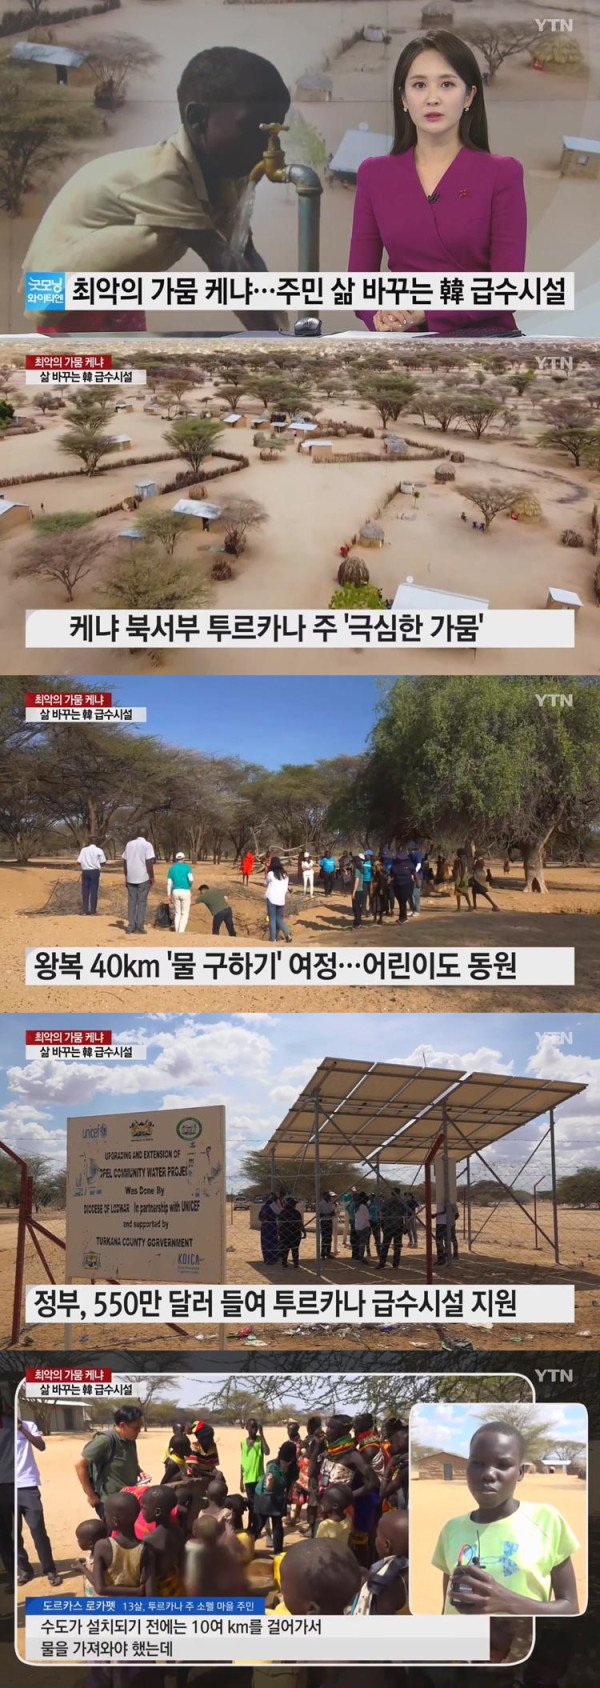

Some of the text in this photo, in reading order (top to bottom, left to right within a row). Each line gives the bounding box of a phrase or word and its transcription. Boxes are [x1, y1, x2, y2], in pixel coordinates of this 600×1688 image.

[82, 1123, 101, 1139] unicef
[104, 1149, 181, 1160] UPGRADING AND EXTENSION OF
[113, 1167, 146, 1179] COMMUNITY
[147, 1166, 167, 1178] WATER
[125, 1186, 165, 1196] Was Done By
[83, 1204, 103, 1214] DIOCESE
[104, 1204, 110, 1214] OF
[110, 1203, 131, 1214] LODWAR
[139, 1201, 169, 1216] partnership
[169, 1201, 181, 1213] with
[181, 1200, 201, 1212] UNICEF
[123, 1219, 169, 1230] and supported by
[96, 1237, 122, 1247] TURKANA
[122, 1237, 146, 1247] COUNTY
[177, 1253, 201, 1265] KOICA
